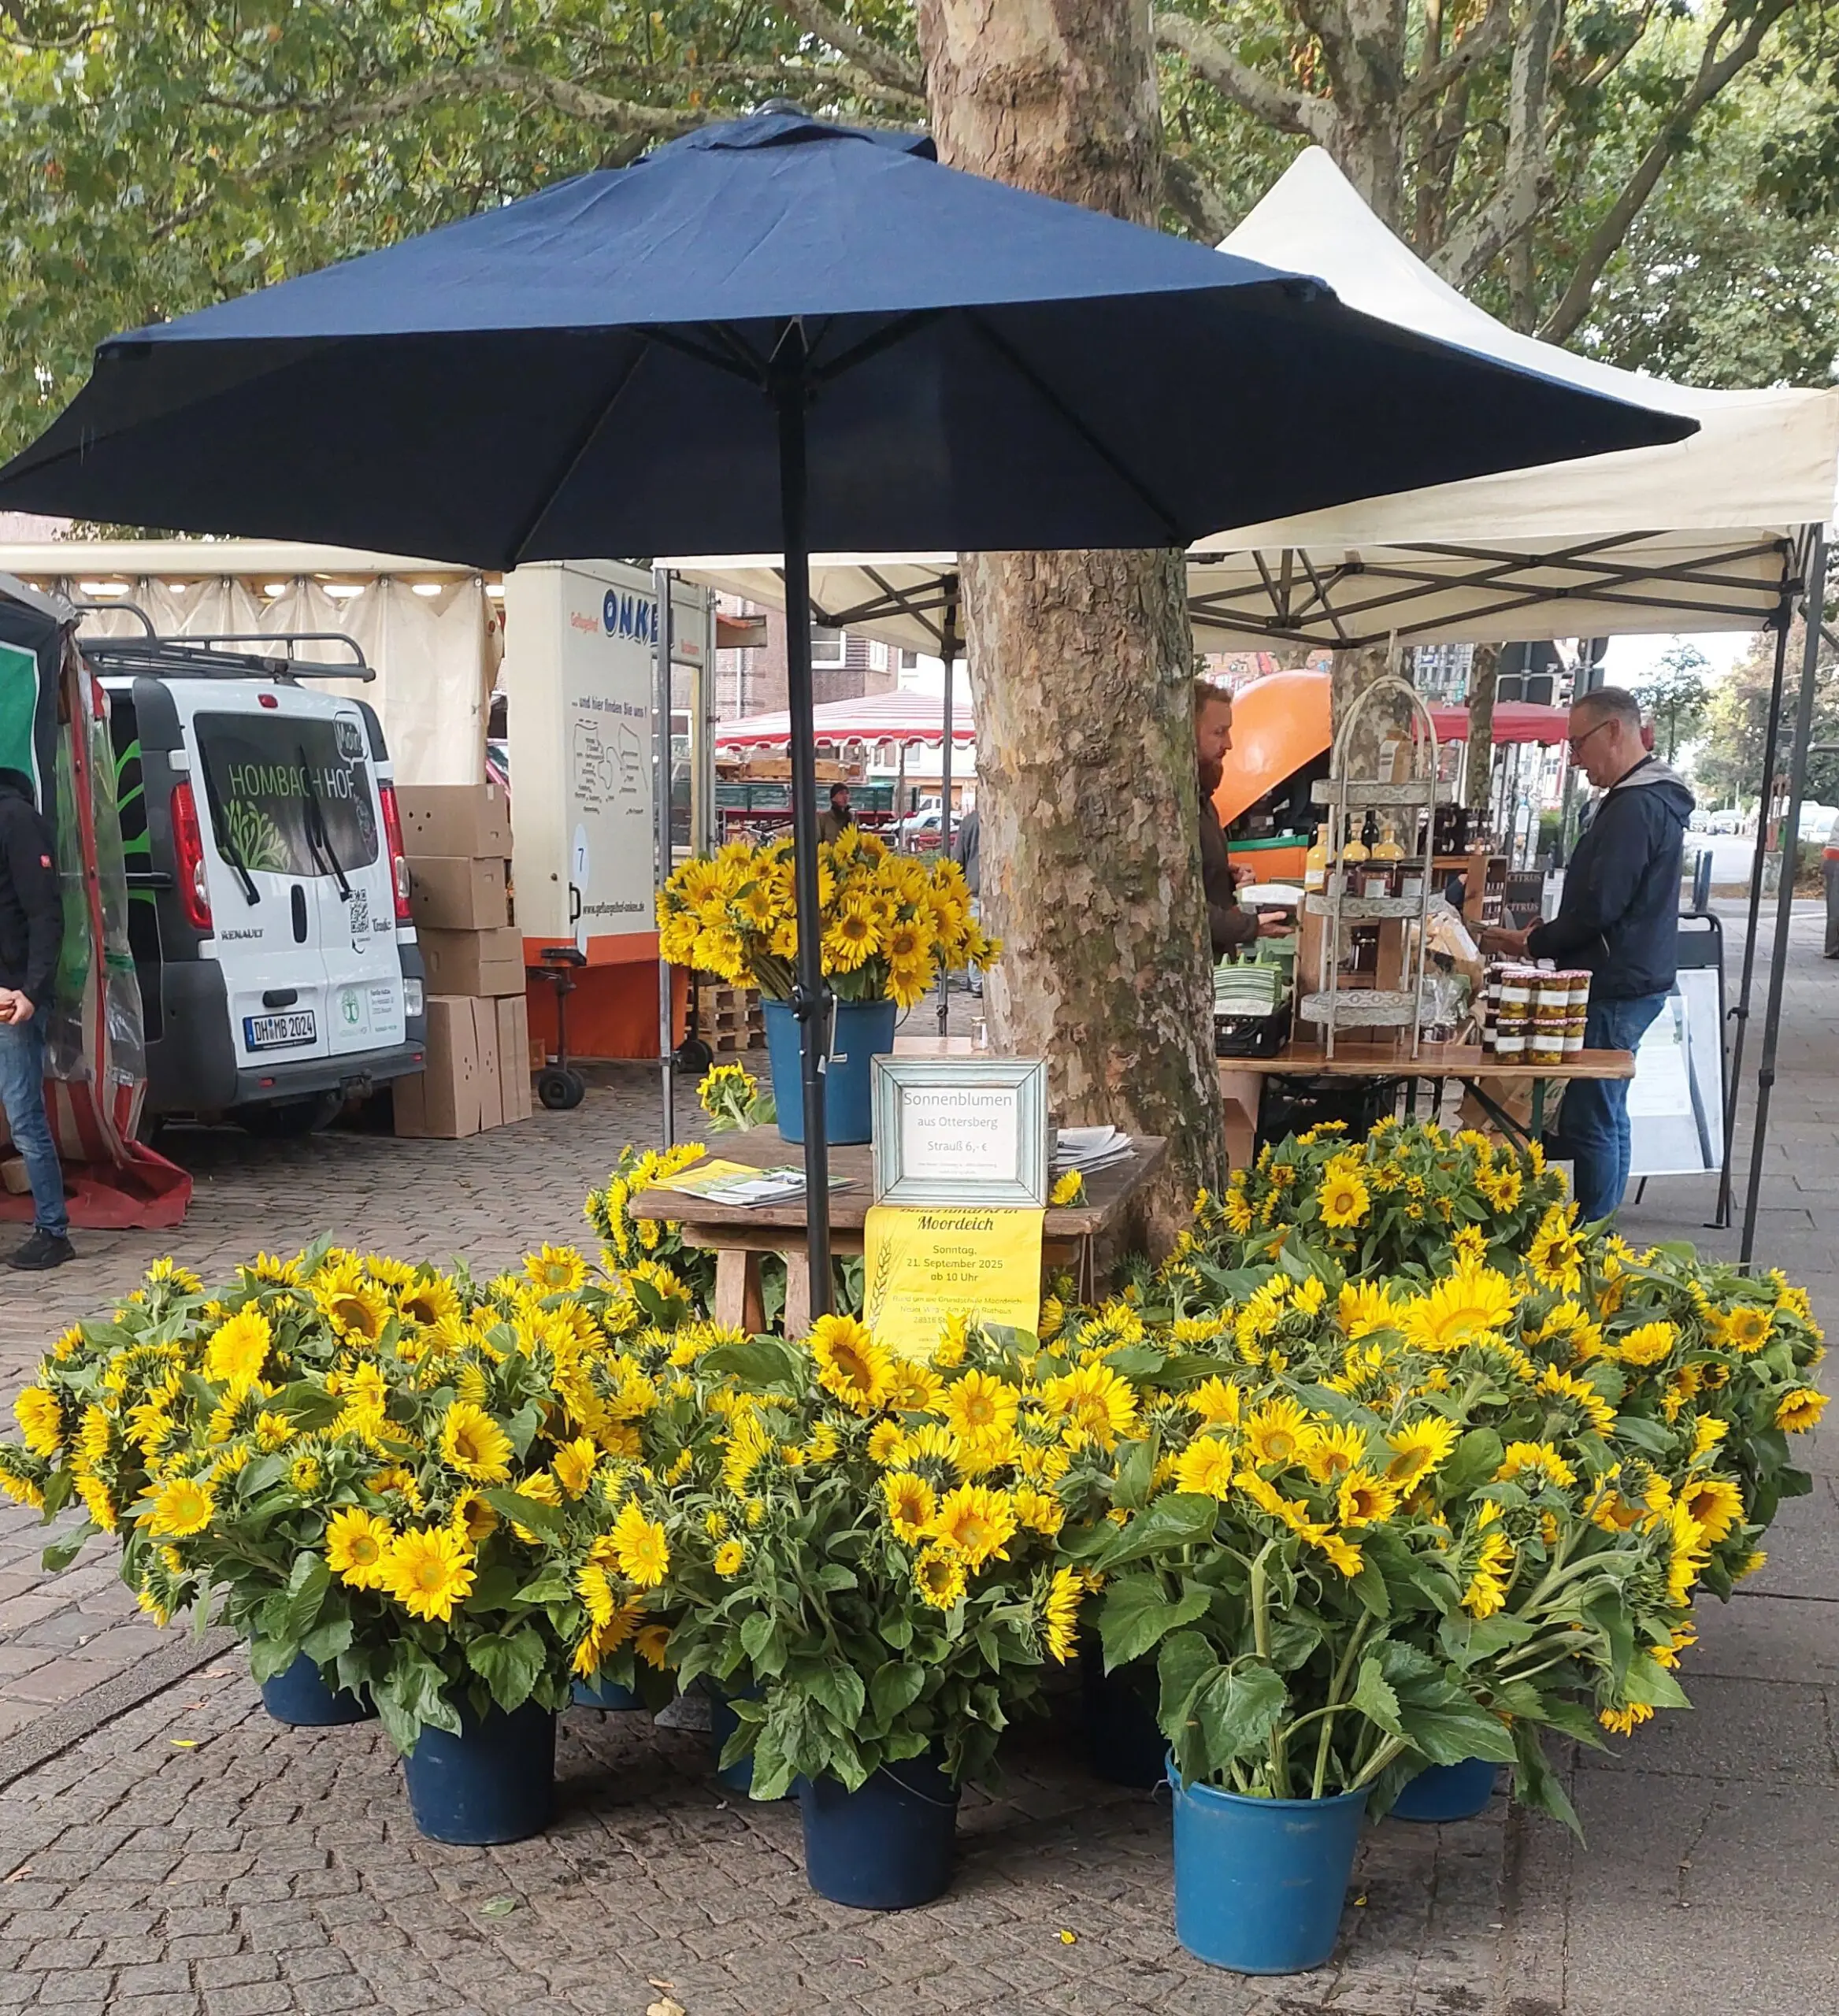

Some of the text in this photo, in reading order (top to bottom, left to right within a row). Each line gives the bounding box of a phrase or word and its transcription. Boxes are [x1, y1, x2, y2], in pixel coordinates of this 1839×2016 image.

[591, 696, 603, 710] hier
[605, 698, 621, 713] finden
[324, 768, 354, 799] HOF
[577, 847, 584, 872] 7
[221, 928, 264, 941] RENAULT
[254, 1014, 313, 1041] DH MB 2024
[903, 1092, 1012, 1106] Sonnenblumen
[918, 1116, 998, 1130] aus Ottersberg
[927, 1140, 962, 1151] Strauß
[918, 1216, 993, 1230] Moordeich
[907, 1258, 1003, 1269] 21. September 2025
[930, 1272, 979, 1282] ab 10 Uhr
